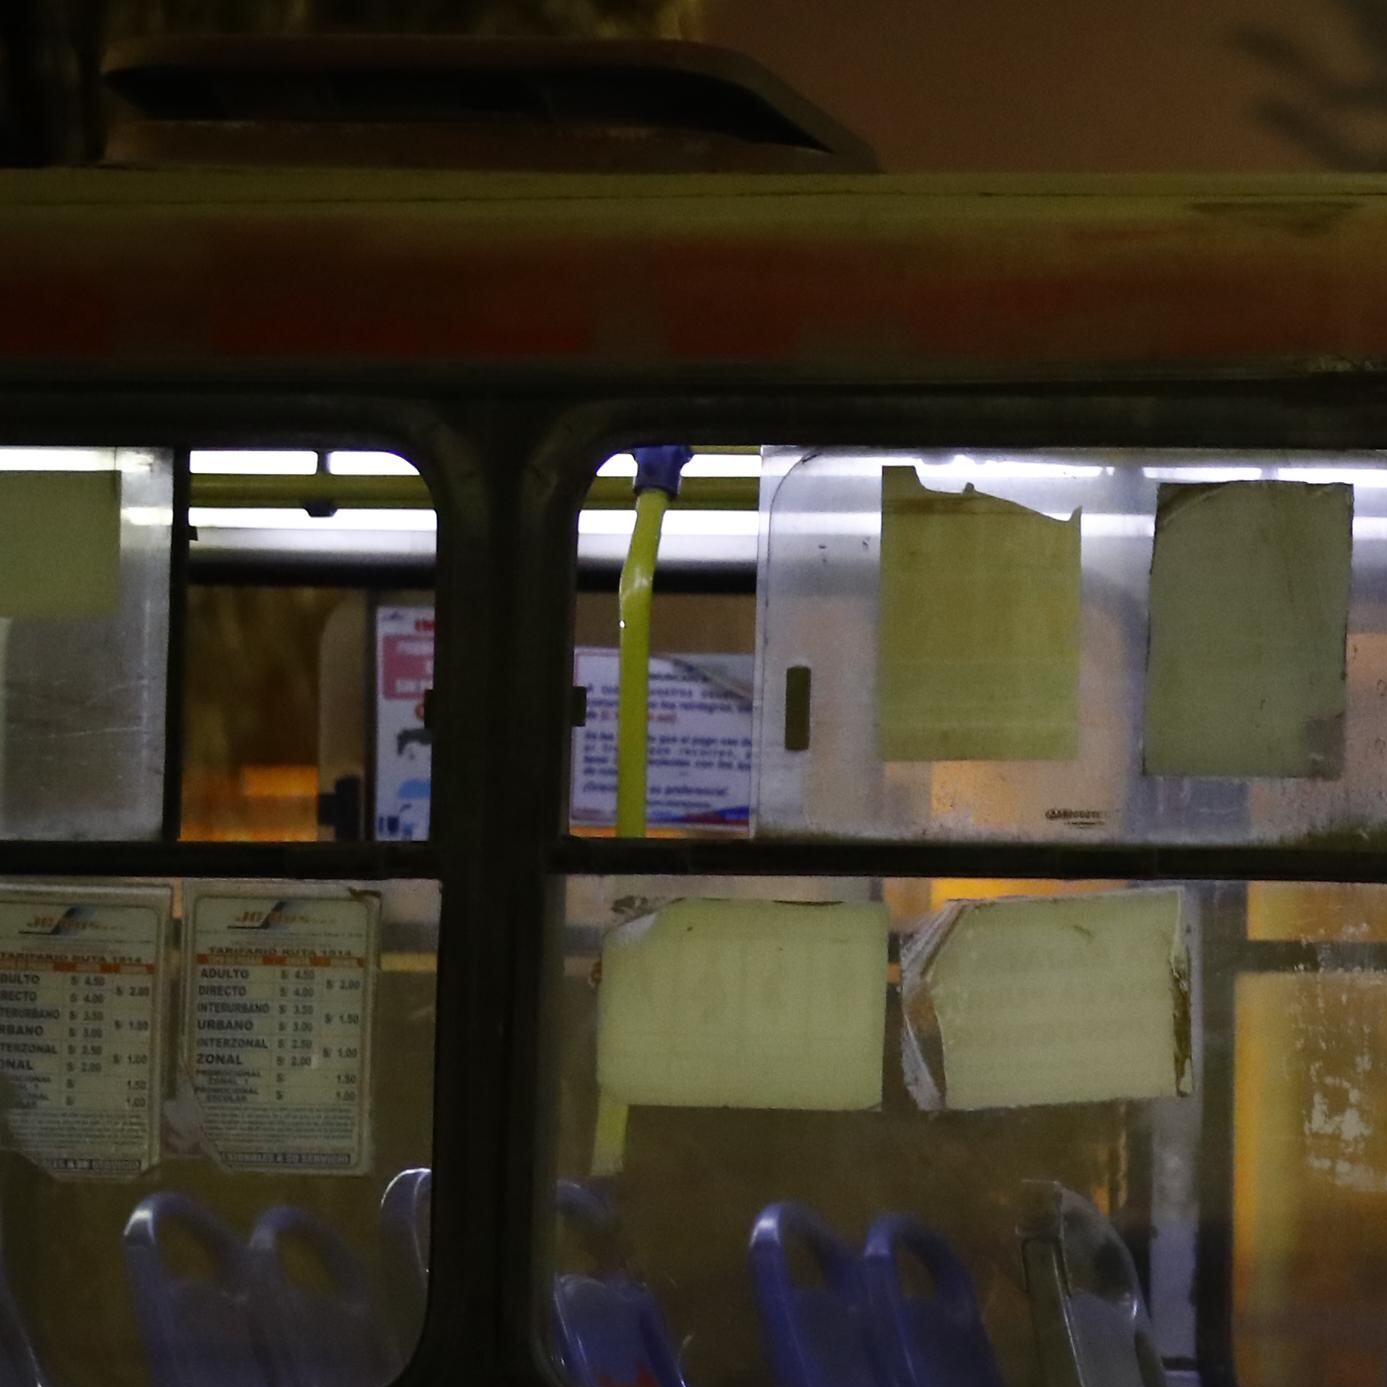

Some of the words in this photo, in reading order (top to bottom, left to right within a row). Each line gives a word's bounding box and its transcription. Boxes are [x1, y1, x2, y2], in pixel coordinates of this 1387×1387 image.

[200, 967, 249, 979] ADULTO
[198, 985, 247, 997] DIRECTO
[197, 1019, 253, 1031] URBANO
[196, 1038, 269, 1049] INTERZONAL
[196, 1053, 244, 1065] ZONAL
